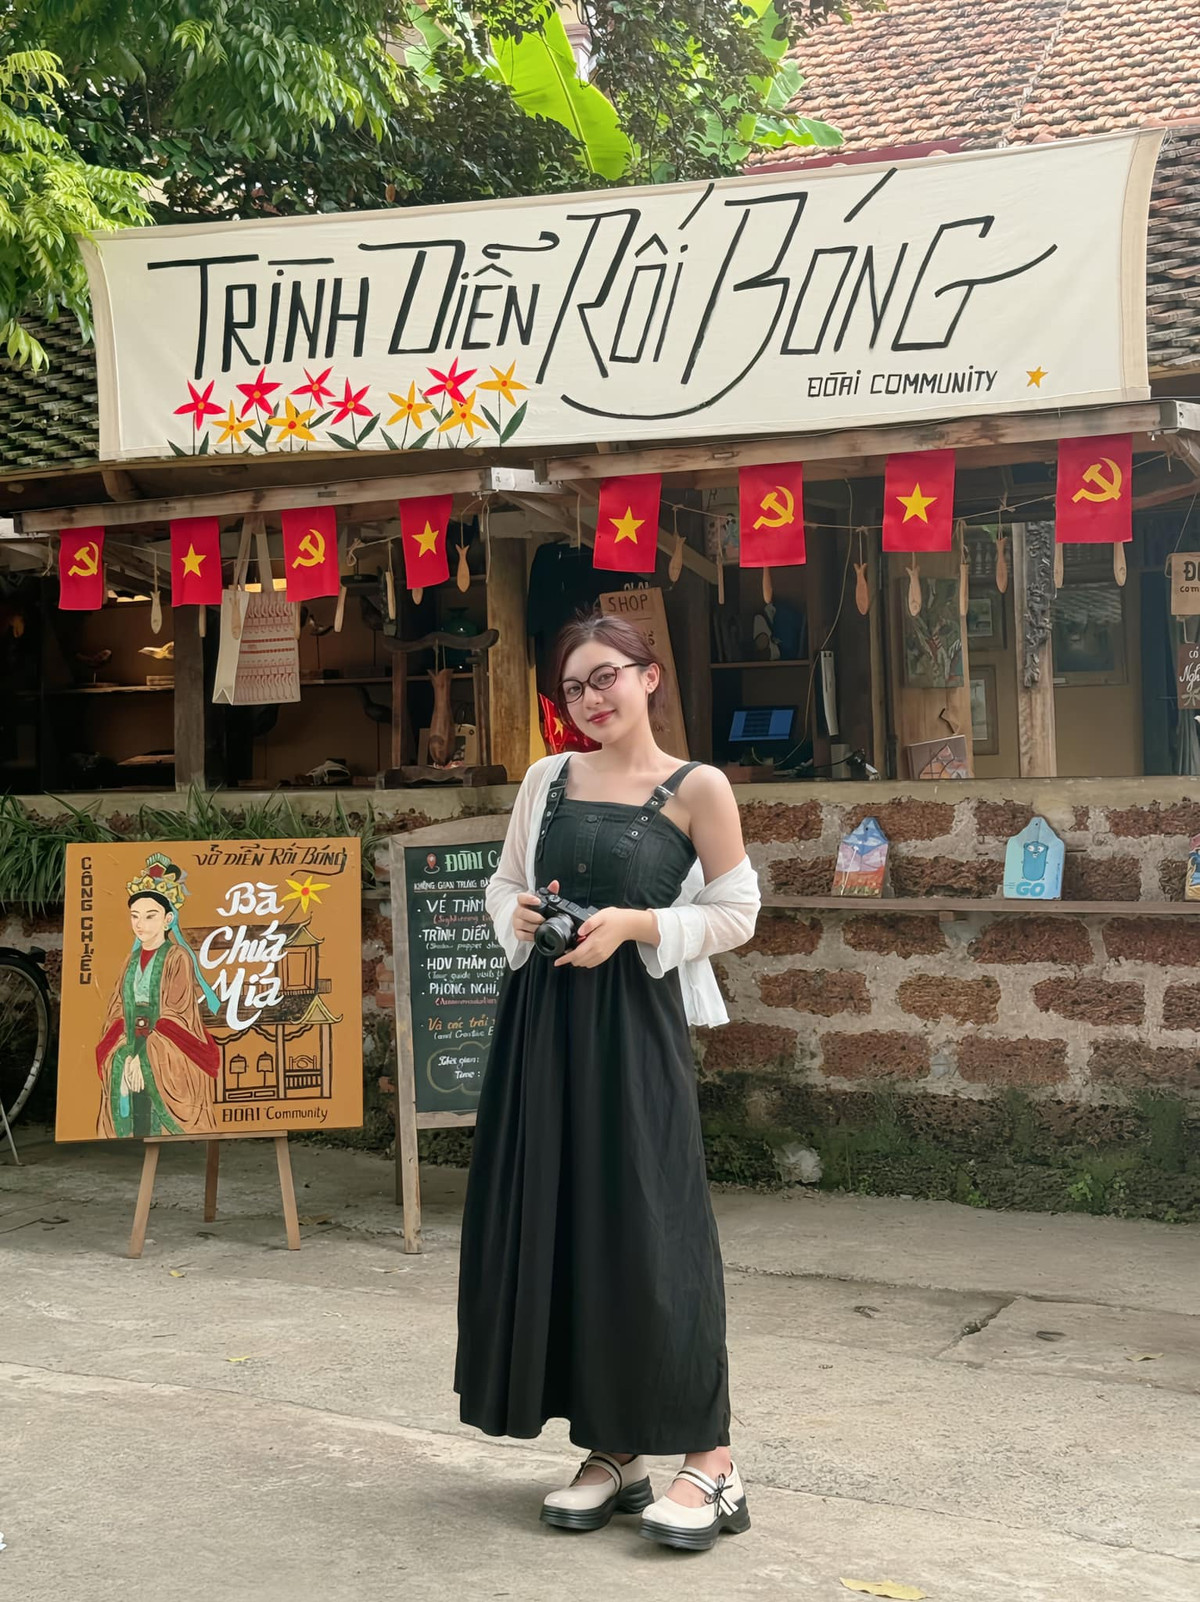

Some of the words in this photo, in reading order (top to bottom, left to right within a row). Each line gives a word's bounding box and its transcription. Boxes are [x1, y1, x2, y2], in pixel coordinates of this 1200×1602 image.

[358, 231, 561, 355] DIỄN
[535, 183, 714, 384] RỐI
[561, 167, 1057, 421] BÓNG
[608, 594, 648, 612] SHOP
[222, 843, 265, 866] DIỄN
[1016, 882, 1045, 897] GO
[425, 893, 448, 913] VÉ
[422, 926, 456, 942] TRÌNH
[461, 923, 490, 942] DIỄN
[427, 957, 453, 971] HDV
[456, 954, 487, 970] THĂM
[265, 1106, 328, 1124] Community
